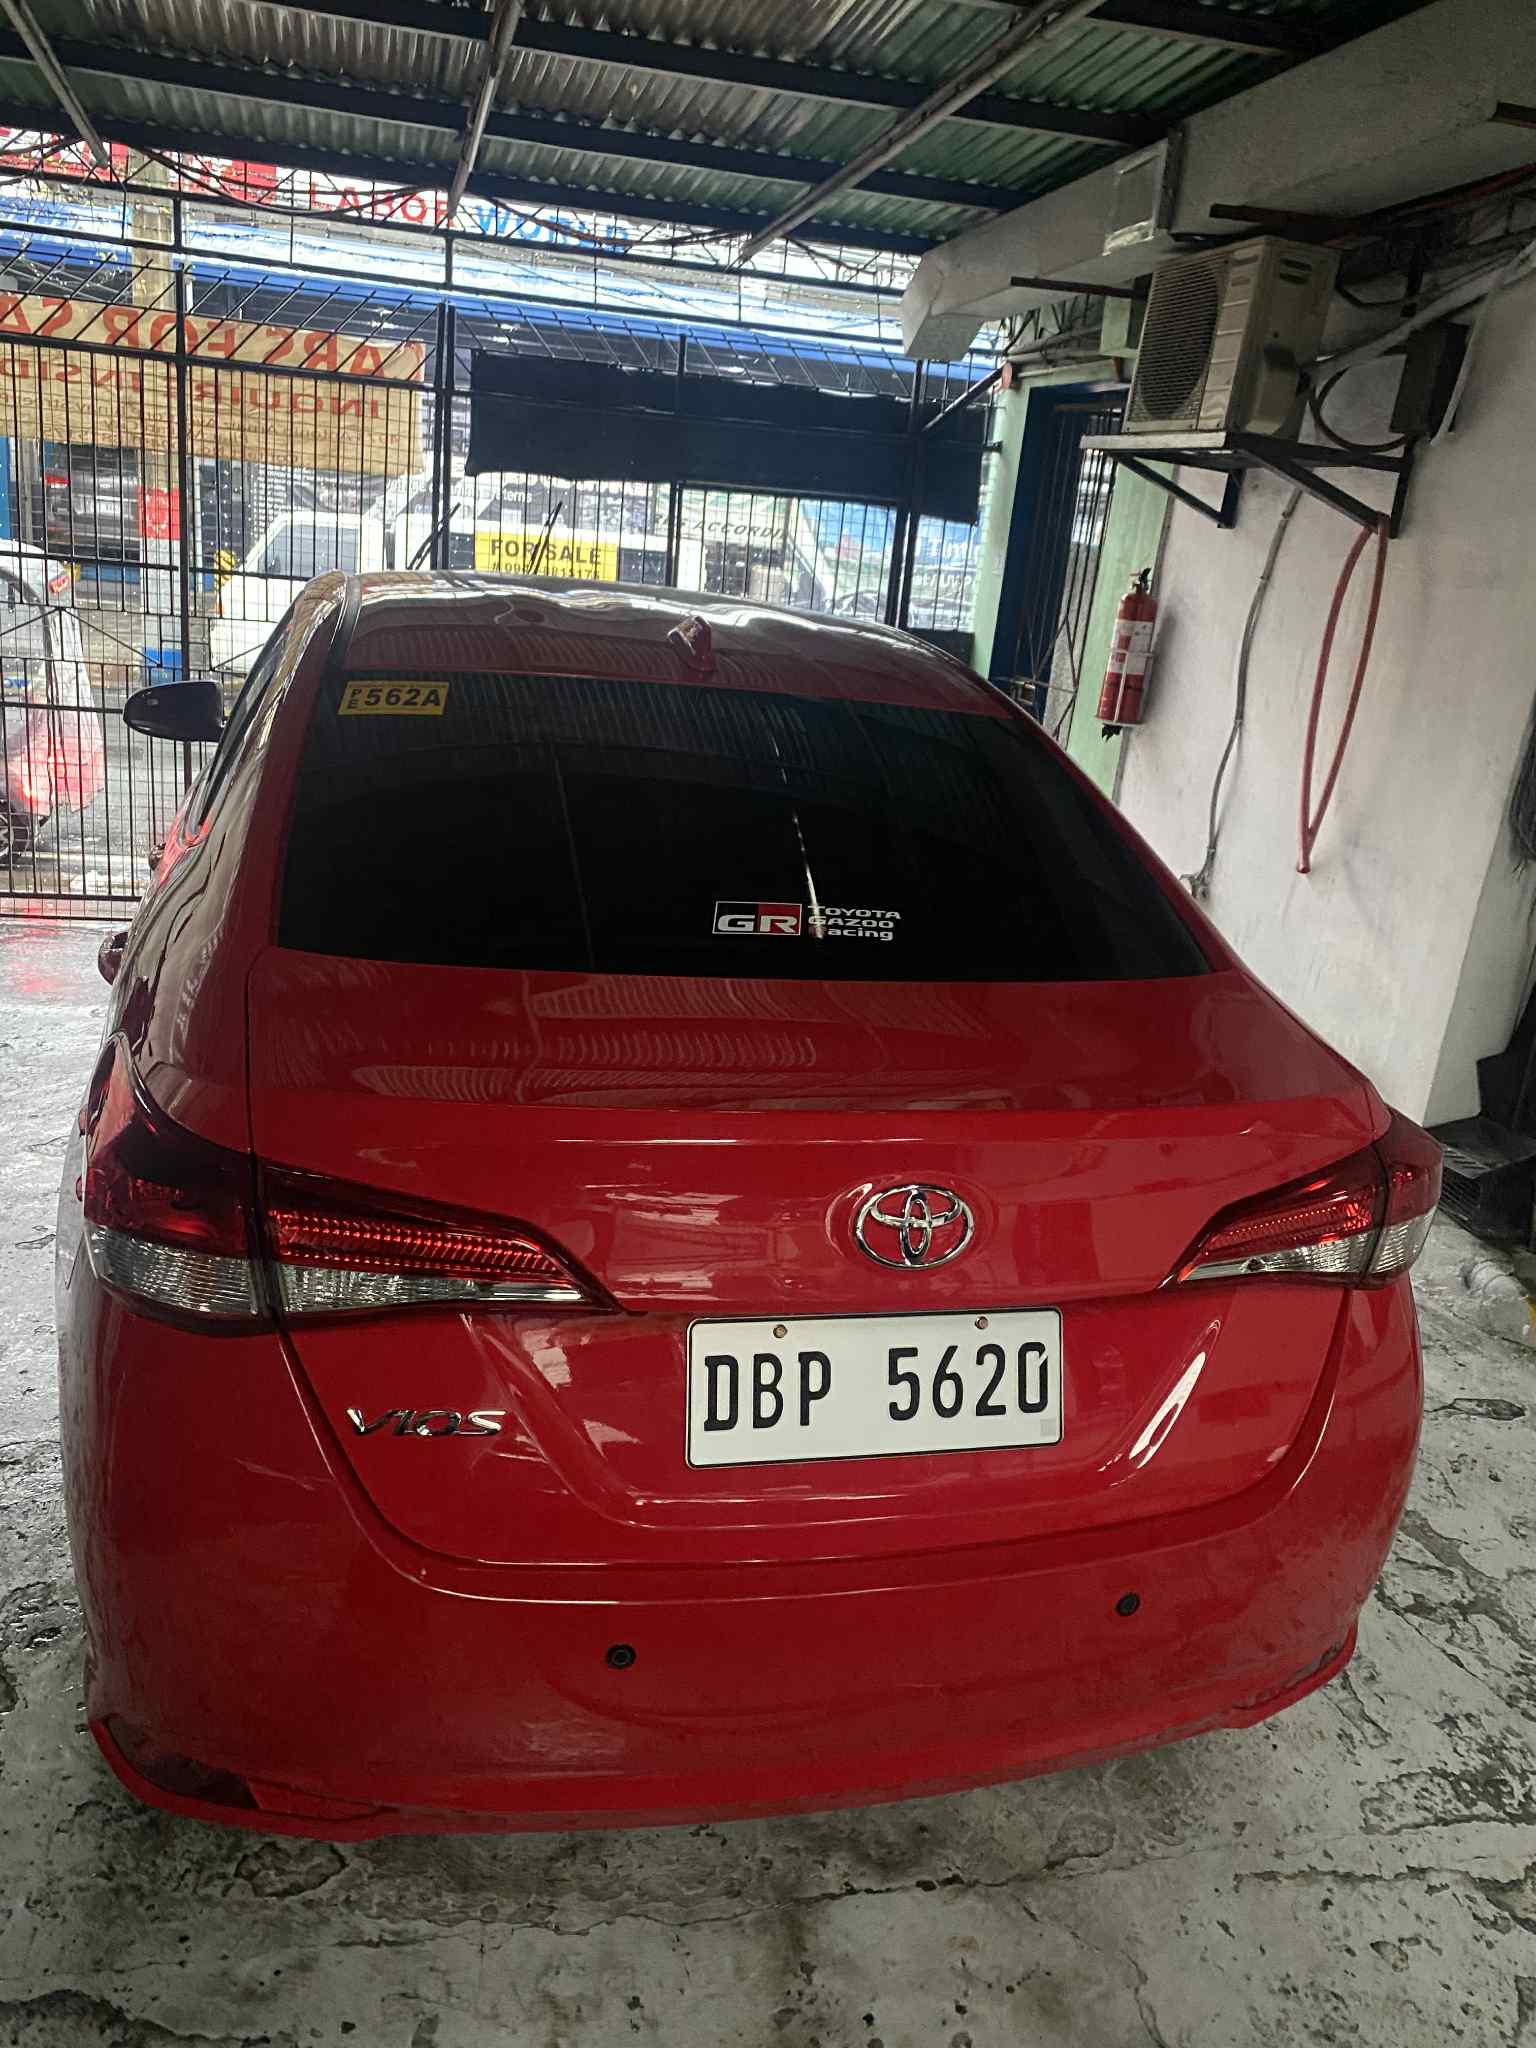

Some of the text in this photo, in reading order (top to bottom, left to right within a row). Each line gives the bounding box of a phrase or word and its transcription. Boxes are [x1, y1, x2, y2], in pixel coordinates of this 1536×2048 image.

[491, 539, 602, 565] FOR SALE
[364, 687, 441, 706] 562A
[807, 905, 902, 920] TOYOTA
[807, 915, 895, 929] GAZOO
[716, 913, 799, 934] GR
[702, 1340, 1050, 1433] DBP 5620
[345, 1402, 508, 1436] VIOS
